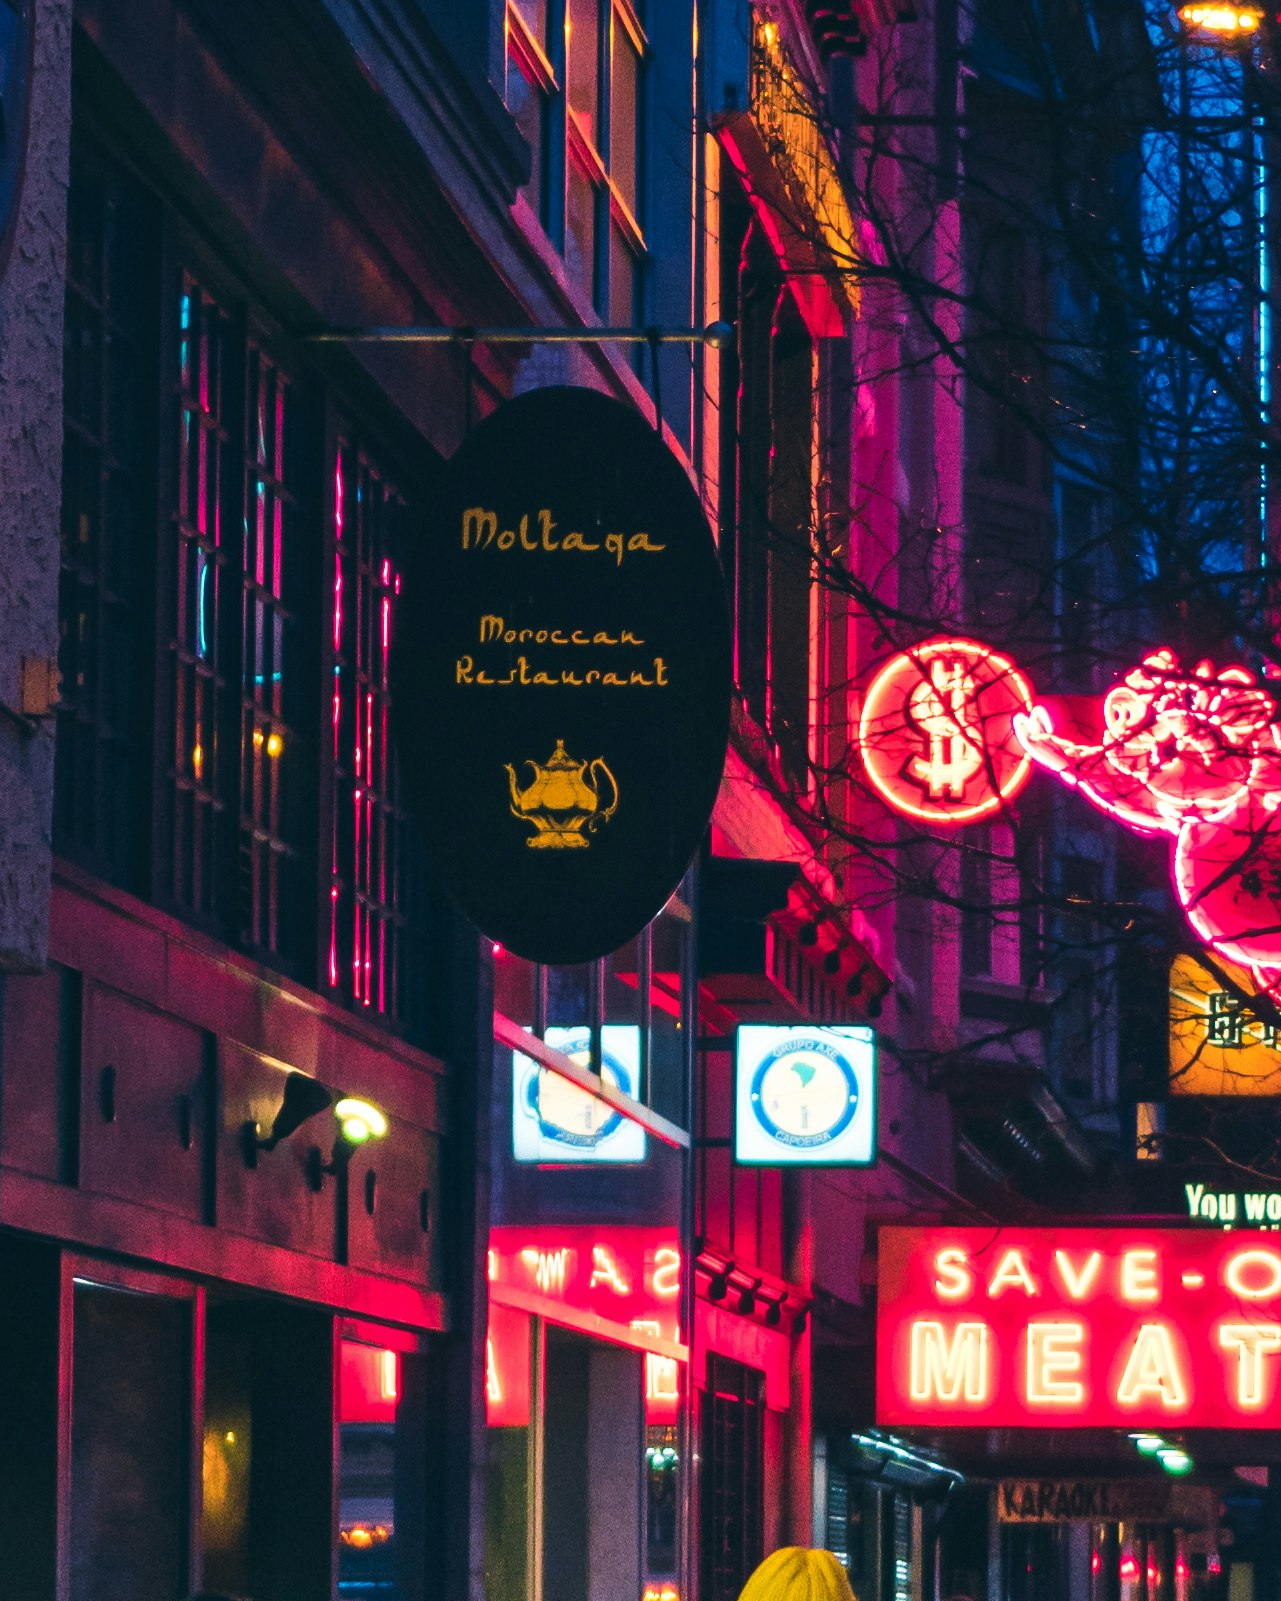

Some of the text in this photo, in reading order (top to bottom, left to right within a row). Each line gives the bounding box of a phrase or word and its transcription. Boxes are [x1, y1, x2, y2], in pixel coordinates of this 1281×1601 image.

[461, 506, 666, 567] Moltaqa
[479, 613, 646, 646] Moroccan
[455, 655, 669, 686] Restaurant
[1185, 1183, 1236, 1221] You
